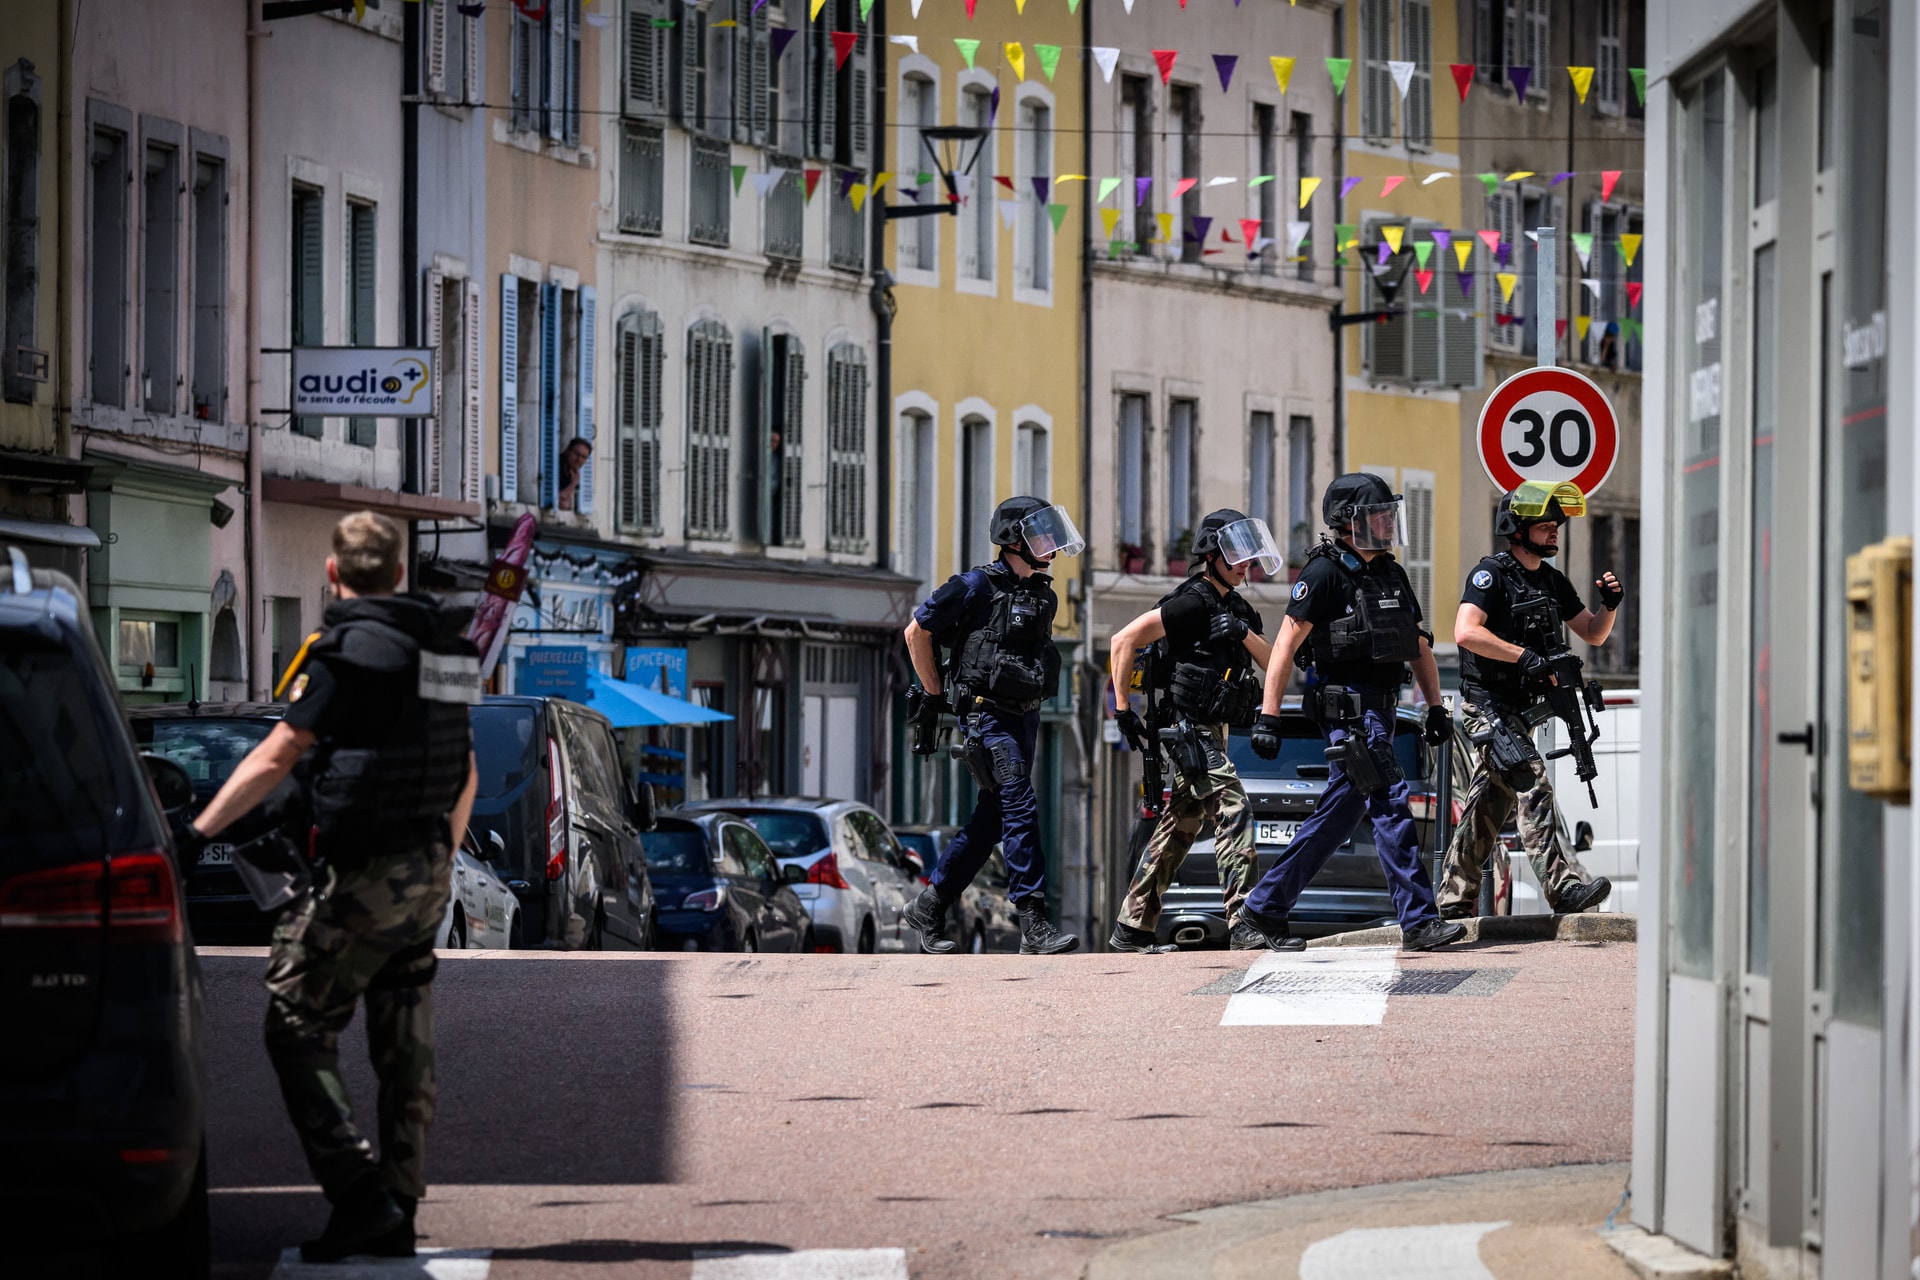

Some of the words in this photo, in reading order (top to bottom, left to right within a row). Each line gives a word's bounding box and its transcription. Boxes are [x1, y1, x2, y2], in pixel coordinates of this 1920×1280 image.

[297, 395, 307, 403] le
[310, 396, 334, 404] sens
[336, 395, 350, 404] de
[353, 394, 397, 404] l'écoute
[1507, 408, 1591, 467] 30
